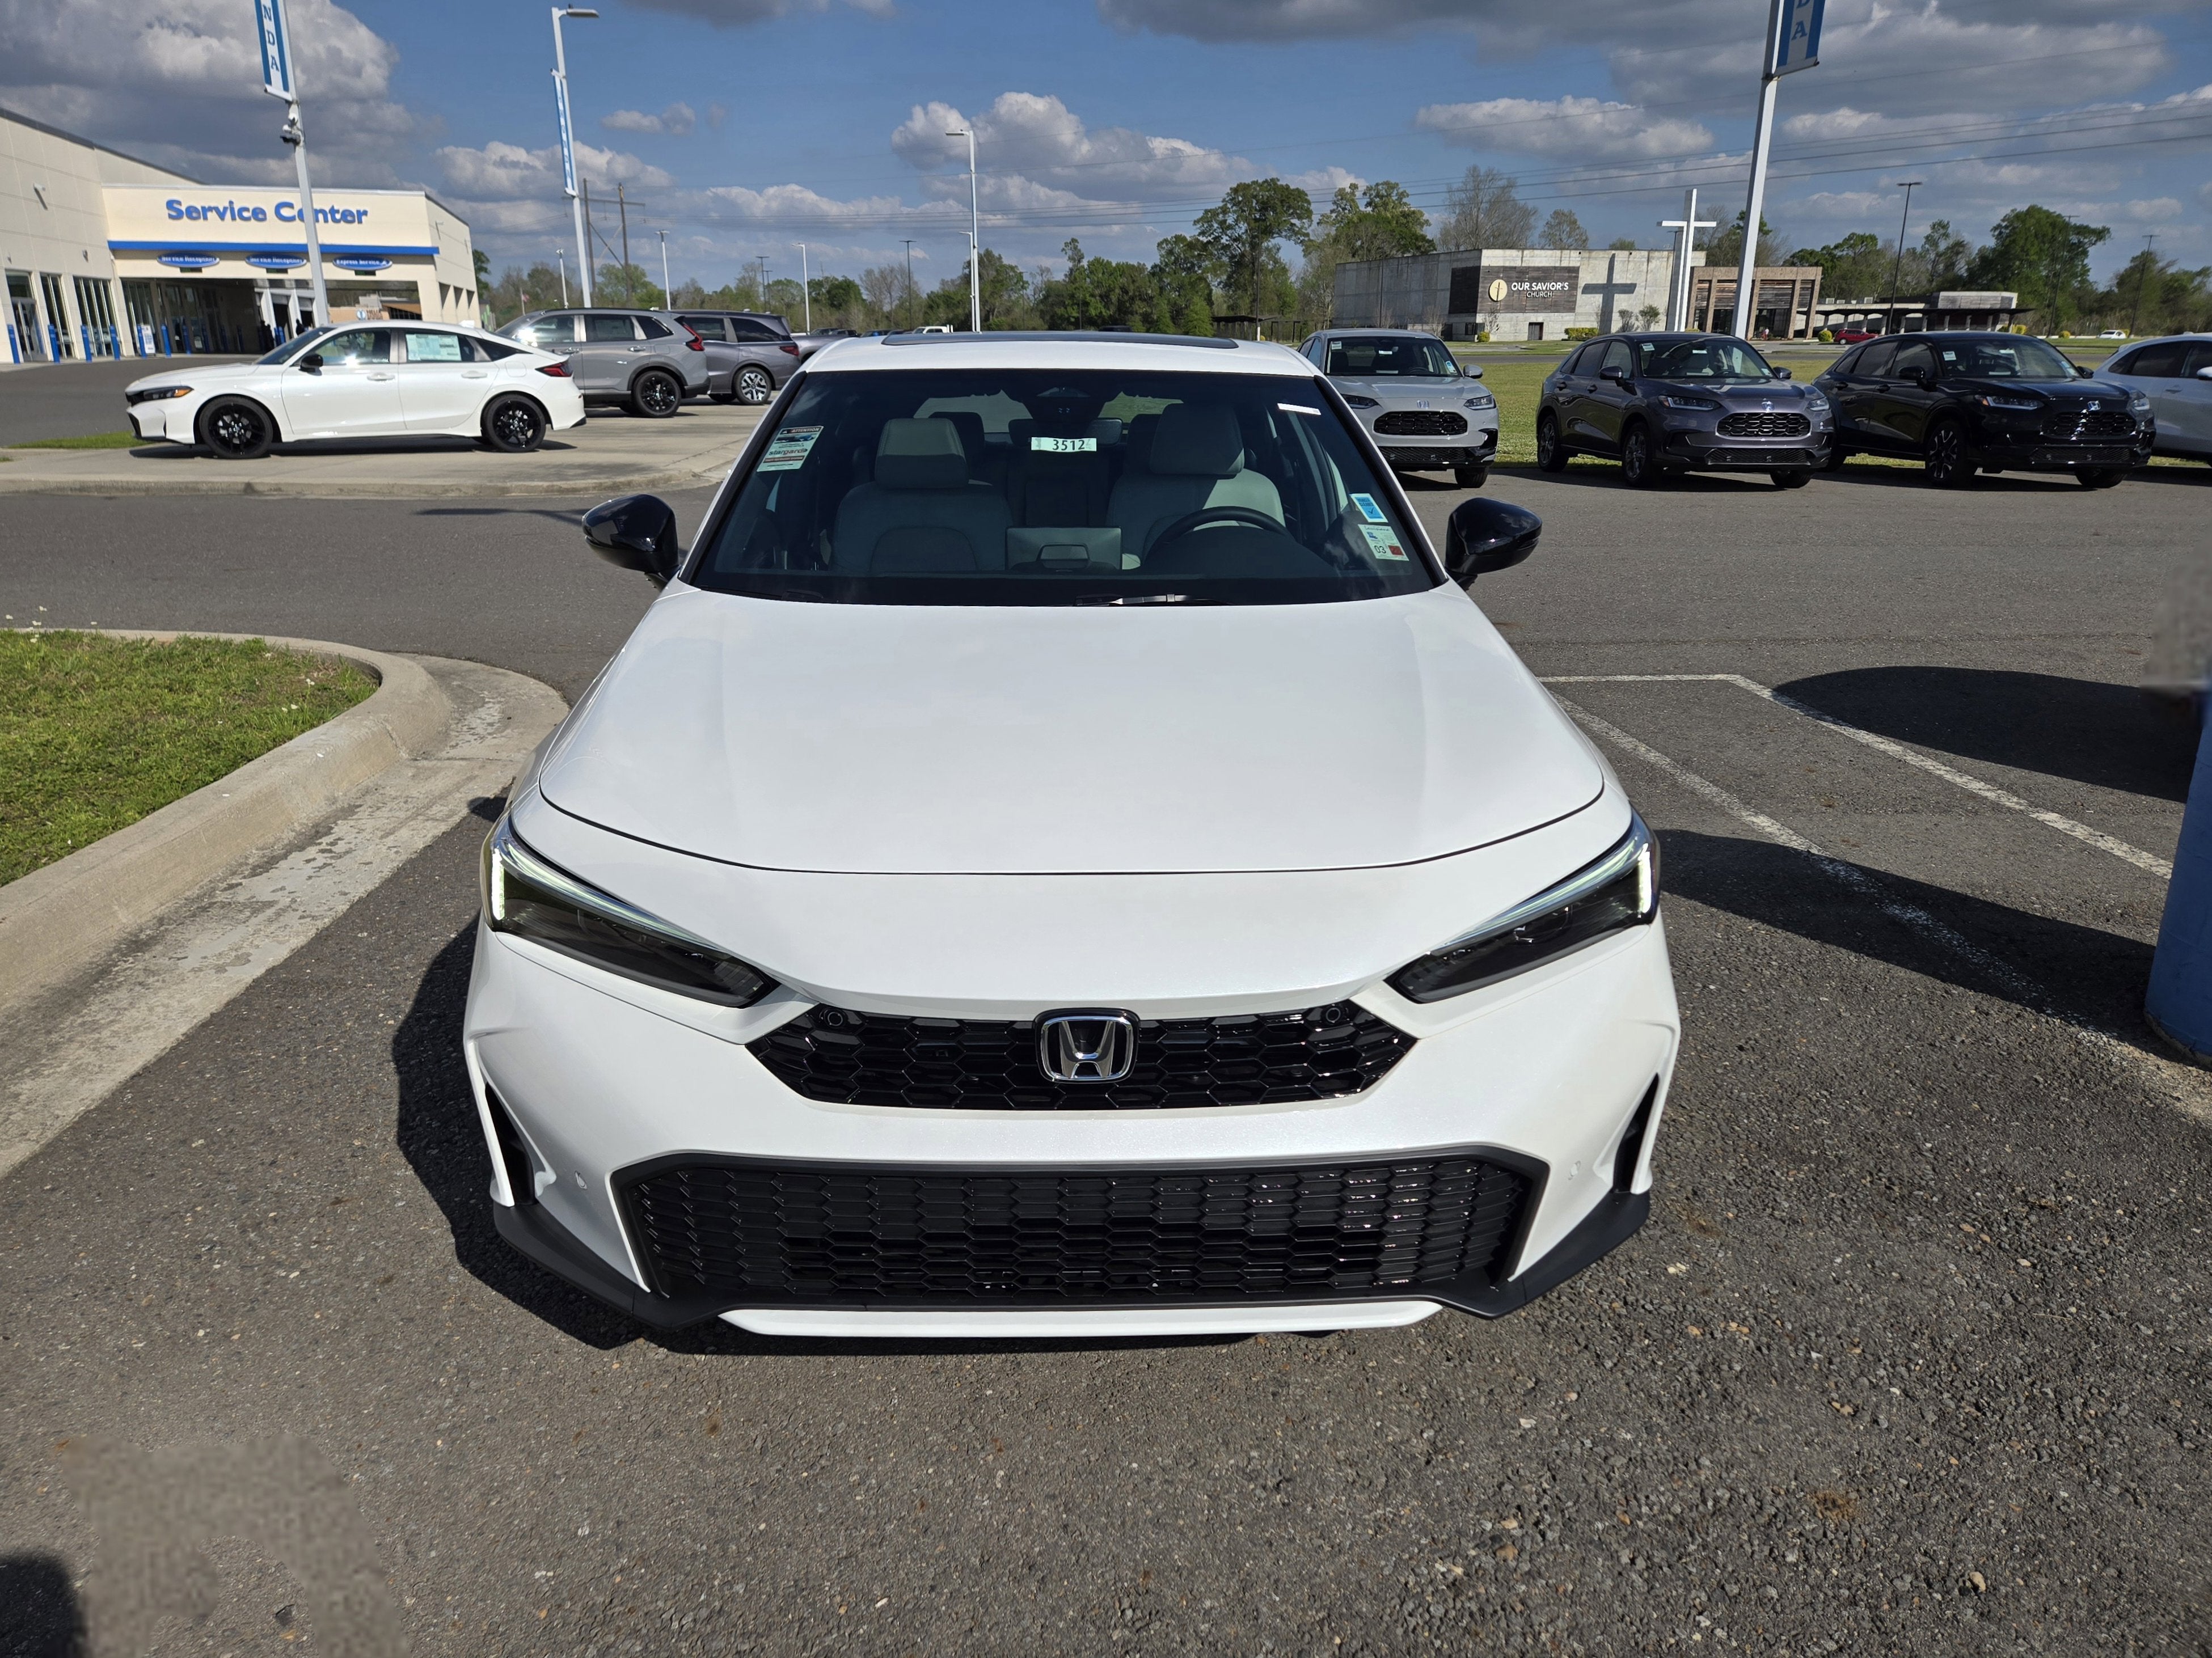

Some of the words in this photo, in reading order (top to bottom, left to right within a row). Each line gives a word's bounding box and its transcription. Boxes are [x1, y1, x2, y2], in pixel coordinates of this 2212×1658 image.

[166, 199, 267, 221] Service
[1511, 282, 1530, 291] OUR
[1531, 282, 1569, 291] SAVIOR'S
[1052, 439, 1085, 451] 3512
[1374, 545, 1387, 554] 03
